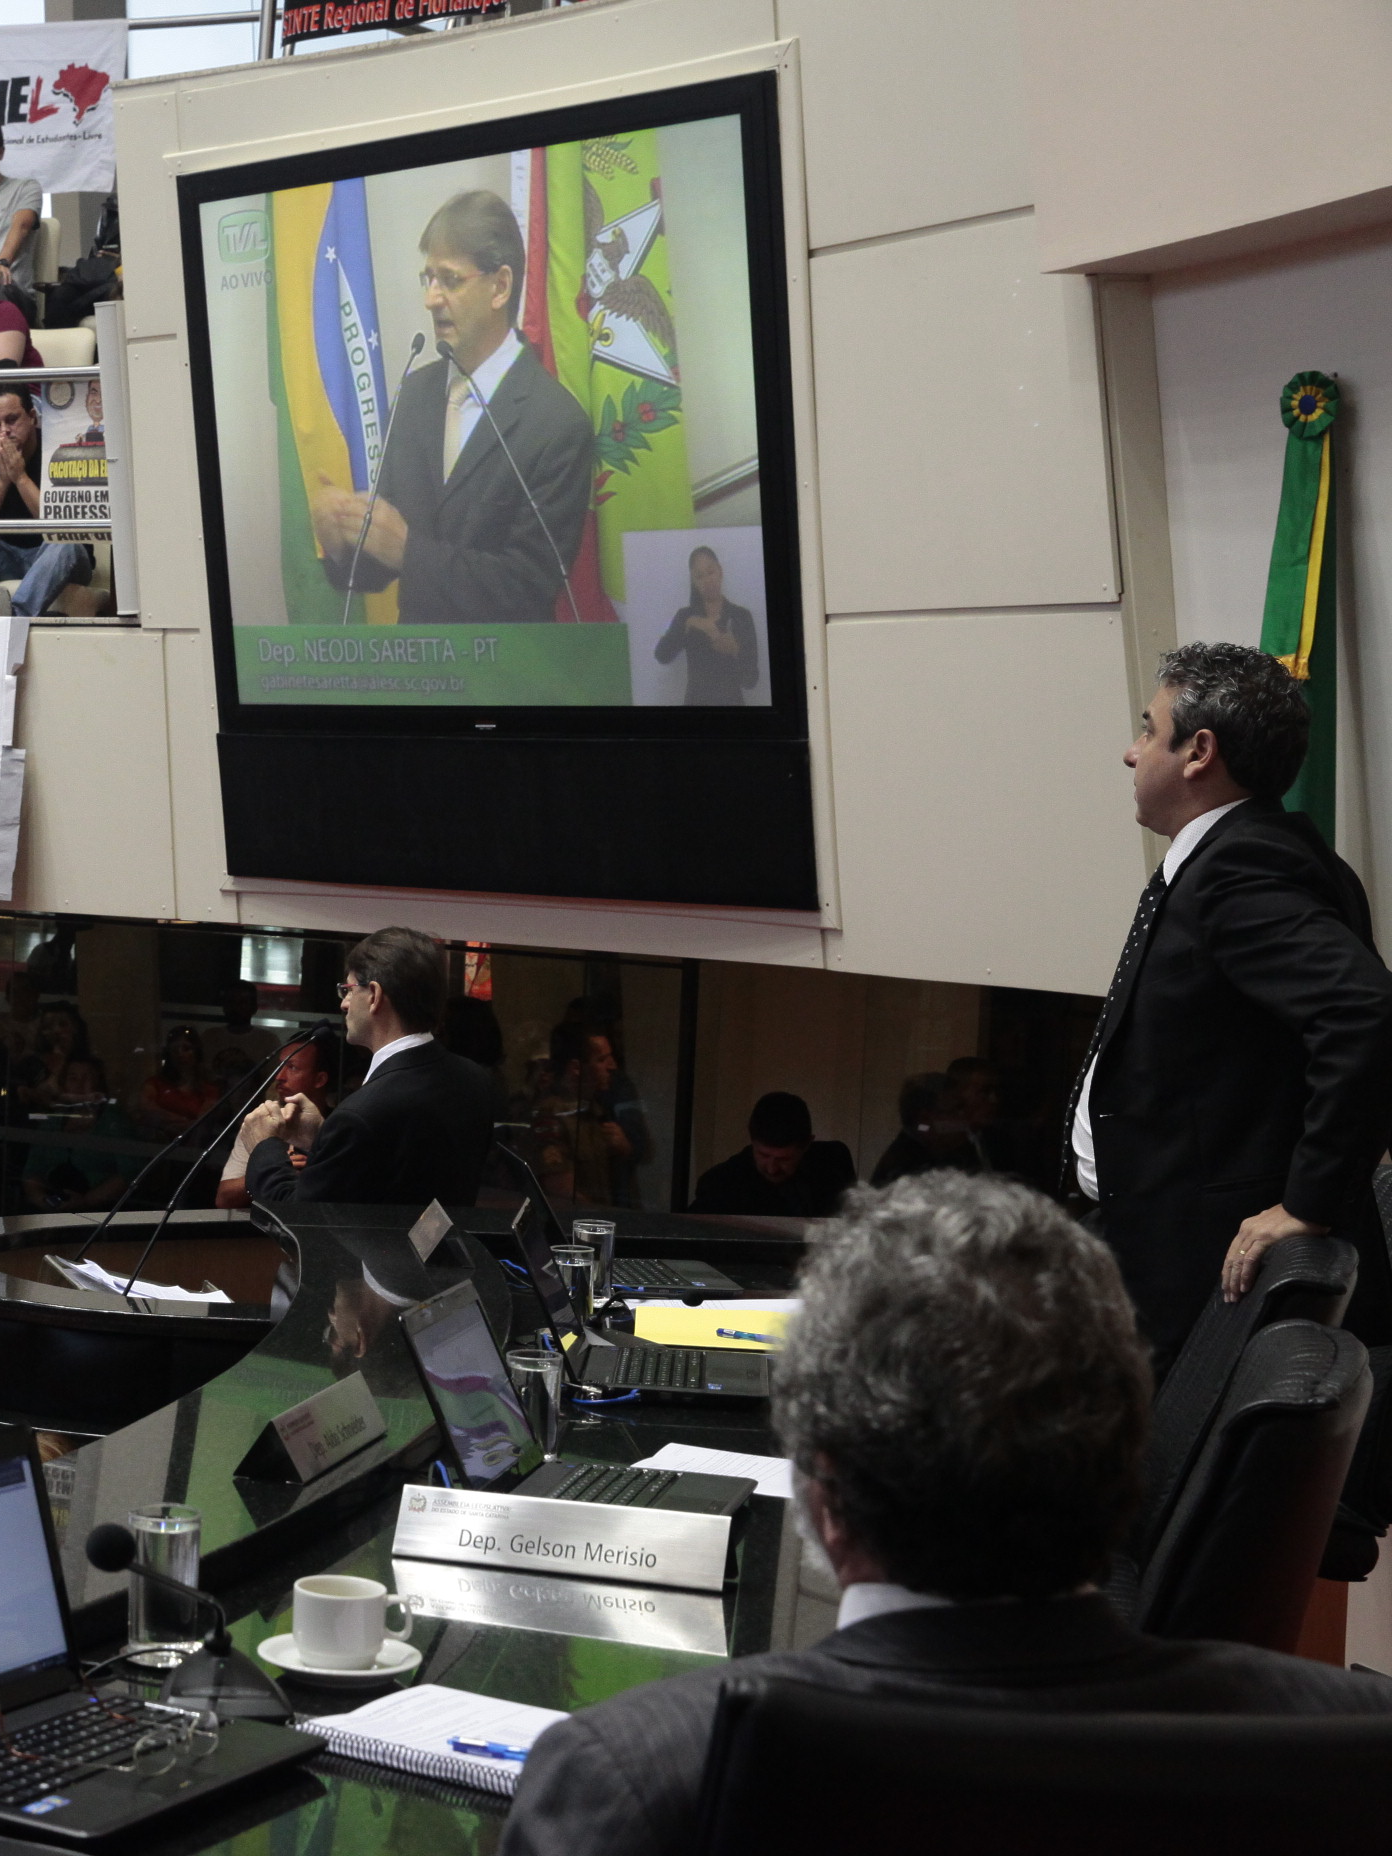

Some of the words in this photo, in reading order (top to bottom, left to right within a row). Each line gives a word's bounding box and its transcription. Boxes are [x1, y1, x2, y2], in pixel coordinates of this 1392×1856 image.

[283, 4, 321, 37] SINTE
[324, 0, 389, 33] Regional
[396, 0, 415, 19] de
[220, 274, 239, 291] AO
[241, 270, 274, 288] VIVO
[44, 490, 92, 503] GOVERNO
[94, 490, 109, 502] EM
[43, 504, 111, 519] PROFESS
[259, 638, 300, 667] Dep.
[304, 638, 364, 663] NEODI
[369, 638, 456, 663] SARETTA
[473, 637, 498, 662] PT
[458, 1528, 501, 1554] Dep.
[509, 1533, 576, 1559] Gelson
[583, 1541, 657, 1569] Merisio
